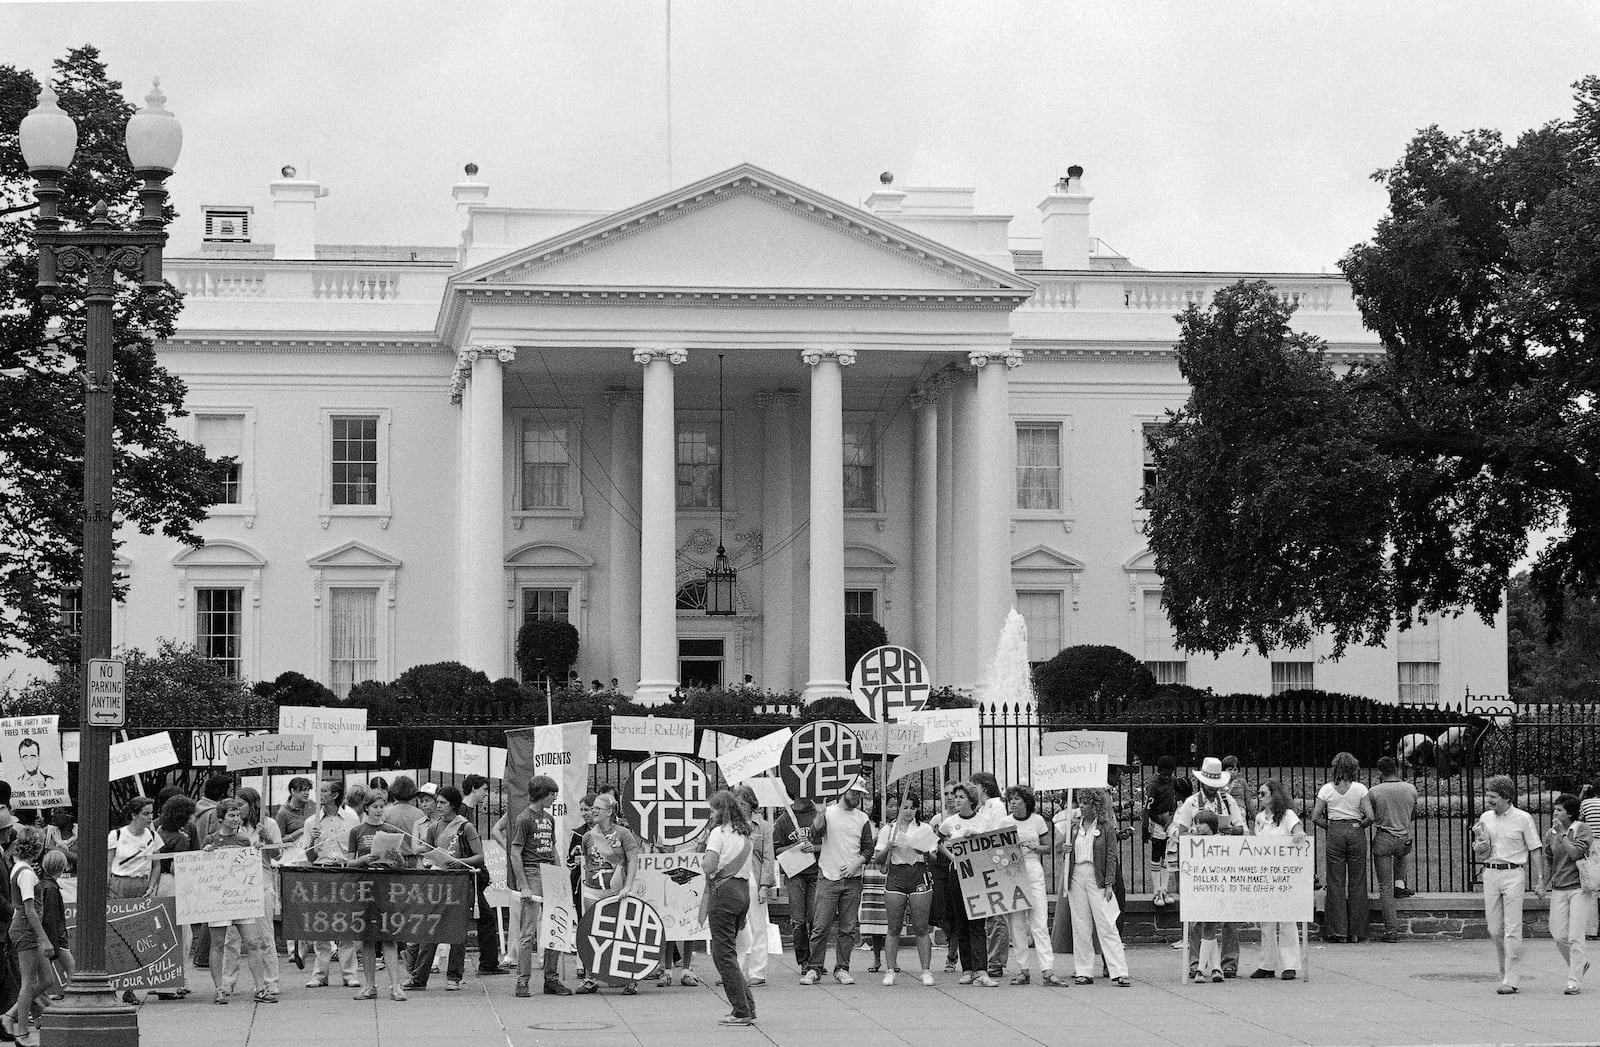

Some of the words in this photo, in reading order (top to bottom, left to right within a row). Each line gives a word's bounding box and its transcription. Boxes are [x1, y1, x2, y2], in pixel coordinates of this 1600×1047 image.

[100, 665, 113, 678] NO
[860, 647, 923, 687] ERA
[91, 680, 122, 693] PARKING
[91, 696, 121, 708] ANYTIME
[859, 684, 929, 724] YES
[25, 718, 39, 726] PARTY
[42, 717, 53, 725] THAT
[284, 716, 293, 728] U
[297, 714, 310, 731] of
[312, 717, 367, 734] Pennsylvania
[32, 727, 48, 735] SLAVES
[891, 729, 920, 743] STATE
[231, 741, 265, 755] National
[267, 741, 306, 752] Cathedral
[791, 722, 858, 764] ERA
[247, 754, 279, 766] School
[535, 752, 571, 767] STUDENTS
[633, 755, 707, 801] ERA
[789, 758, 862, 799] YES
[37, 789, 51, 797] PARTY
[54, 788, 65, 796] THAT
[552, 803, 567, 816] ERA
[630, 800, 711, 846] YES
[953, 830, 1018, 856] STUDENT
[638, 855, 706, 870] IPLOMA
[1193, 875, 1219, 883] DOLLAR
[1221, 875, 1227, 883] A
[1230, 875, 1246, 883] MAN
[1272, 875, 1292, 883] WHAT
[291, 880, 375, 903] ALICE
[388, 882, 460, 905] PAUL
[1193, 884, 1225, 892] HAPPENS
[1228, 884, 1237, 892] TO
[1239, 884, 1251, 892] THE
[1253, 884, 1275, 892] OTHER
[106, 899, 151, 914] DOLLAR?
[966, 885, 1032, 918] ERA
[154, 916, 161, 929] 1
[590, 896, 663, 946] ERA
[136, 934, 157, 953] ONE
[588, 935, 661, 980] YES
[148, 958, 176, 975] FULL
[123, 976, 144, 987] OUR
[147, 965, 182, 986] VALUE!!
